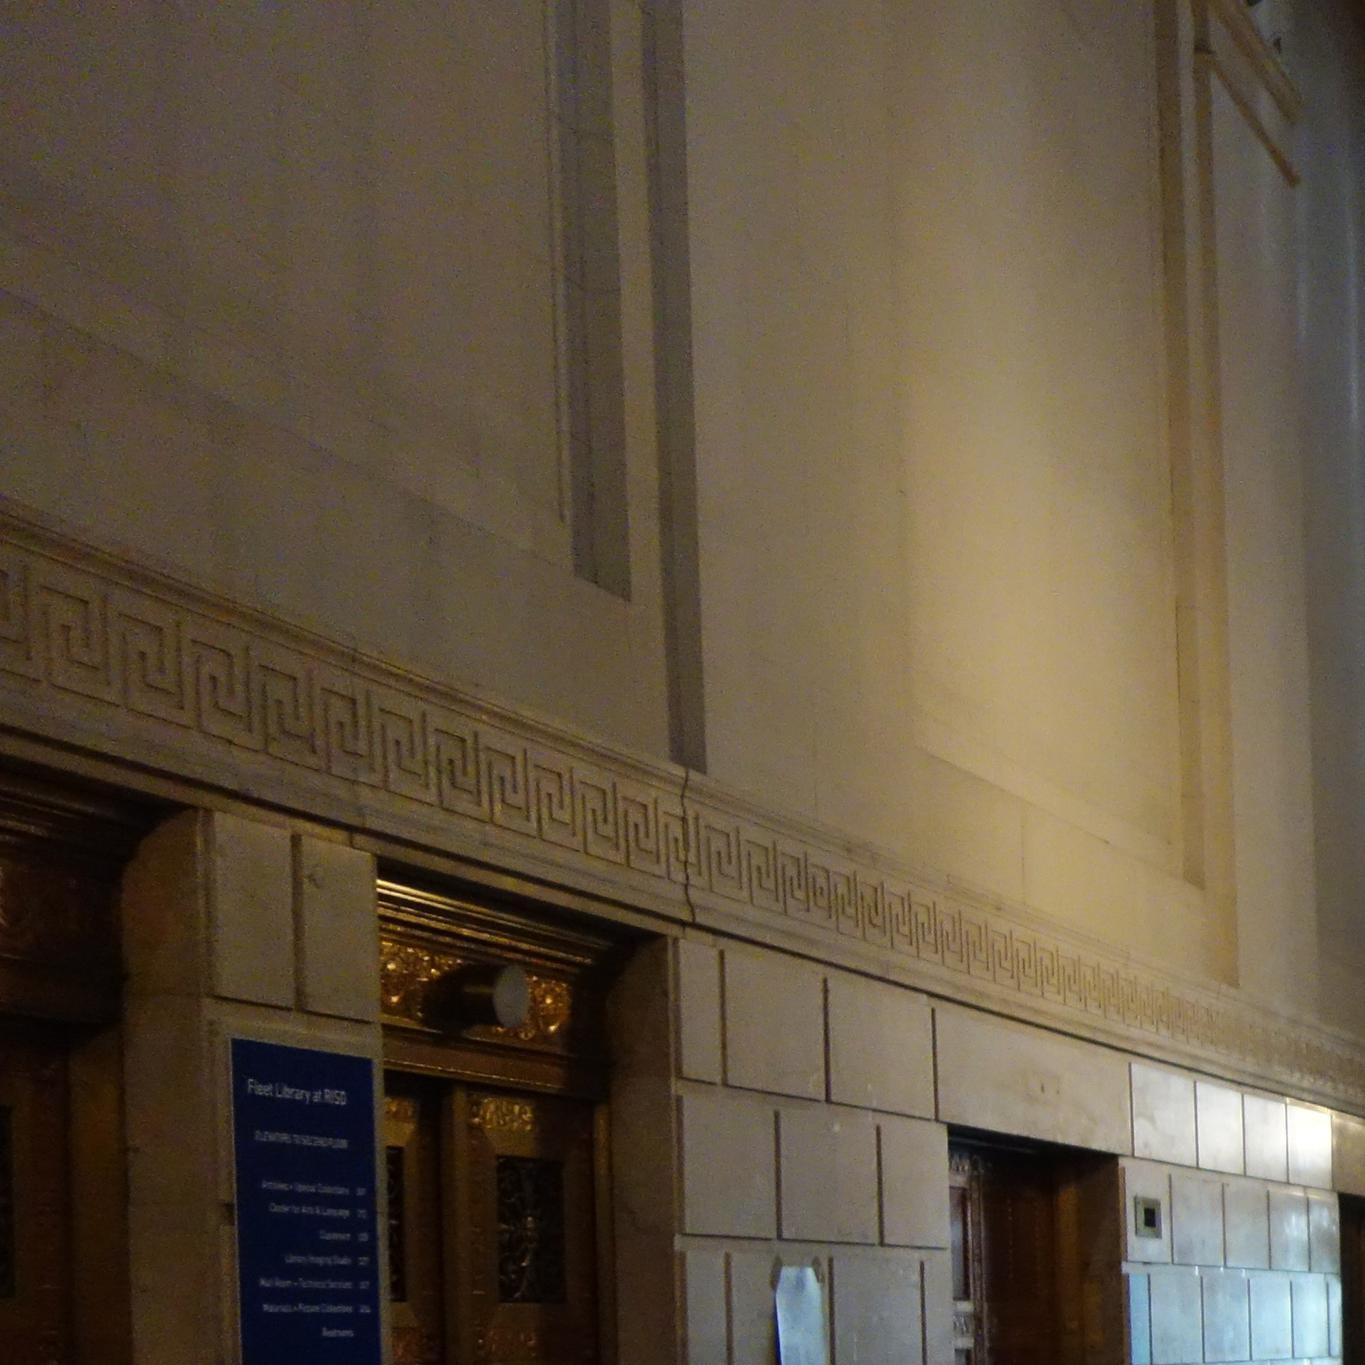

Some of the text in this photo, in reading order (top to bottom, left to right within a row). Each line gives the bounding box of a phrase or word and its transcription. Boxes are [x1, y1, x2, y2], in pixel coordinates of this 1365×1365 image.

[246, 1077, 348, 1107] Fleet Library at RISD
